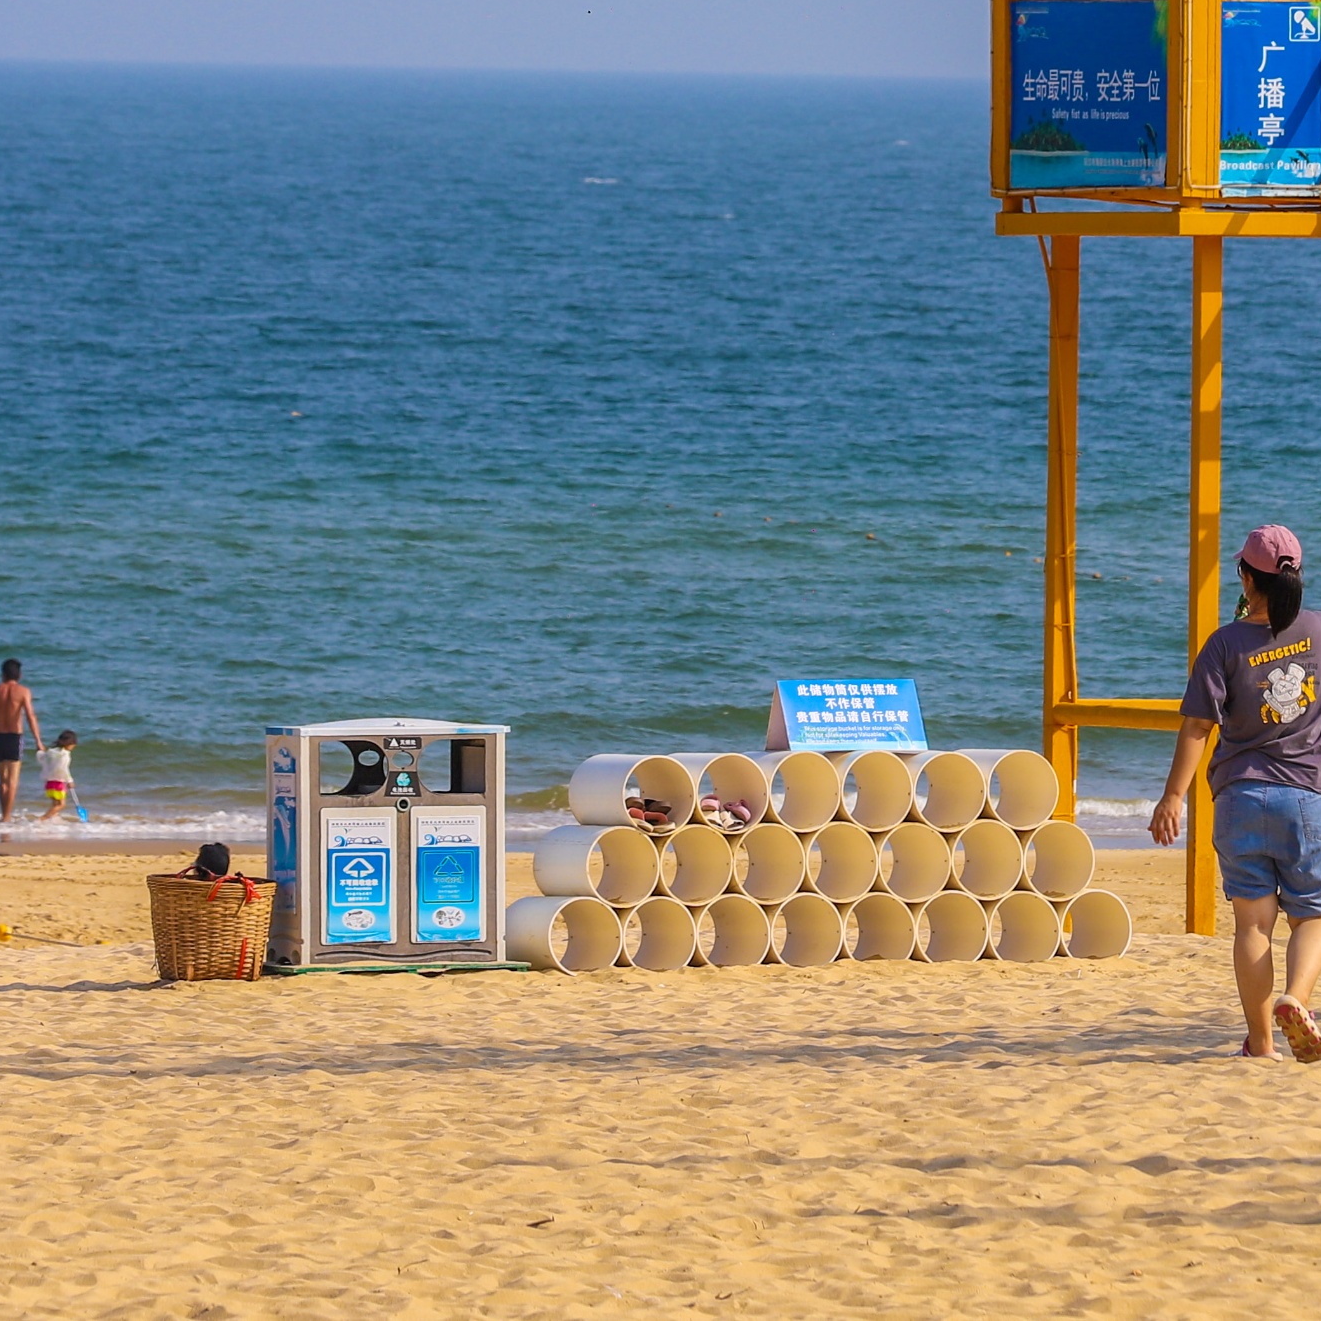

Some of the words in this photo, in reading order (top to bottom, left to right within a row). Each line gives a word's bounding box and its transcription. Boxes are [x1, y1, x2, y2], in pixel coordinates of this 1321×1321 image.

[1258, 41, 1286, 145] 广播亭
[1052, 107, 1069, 121] Safety
[1219, 160, 1274, 170] Broadcast
[1249, 637, 1311, 667] ENERGETIC!
[825, 697, 875, 709] 不作保管
[796, 710, 909, 723] 贵重物品请自行保管
